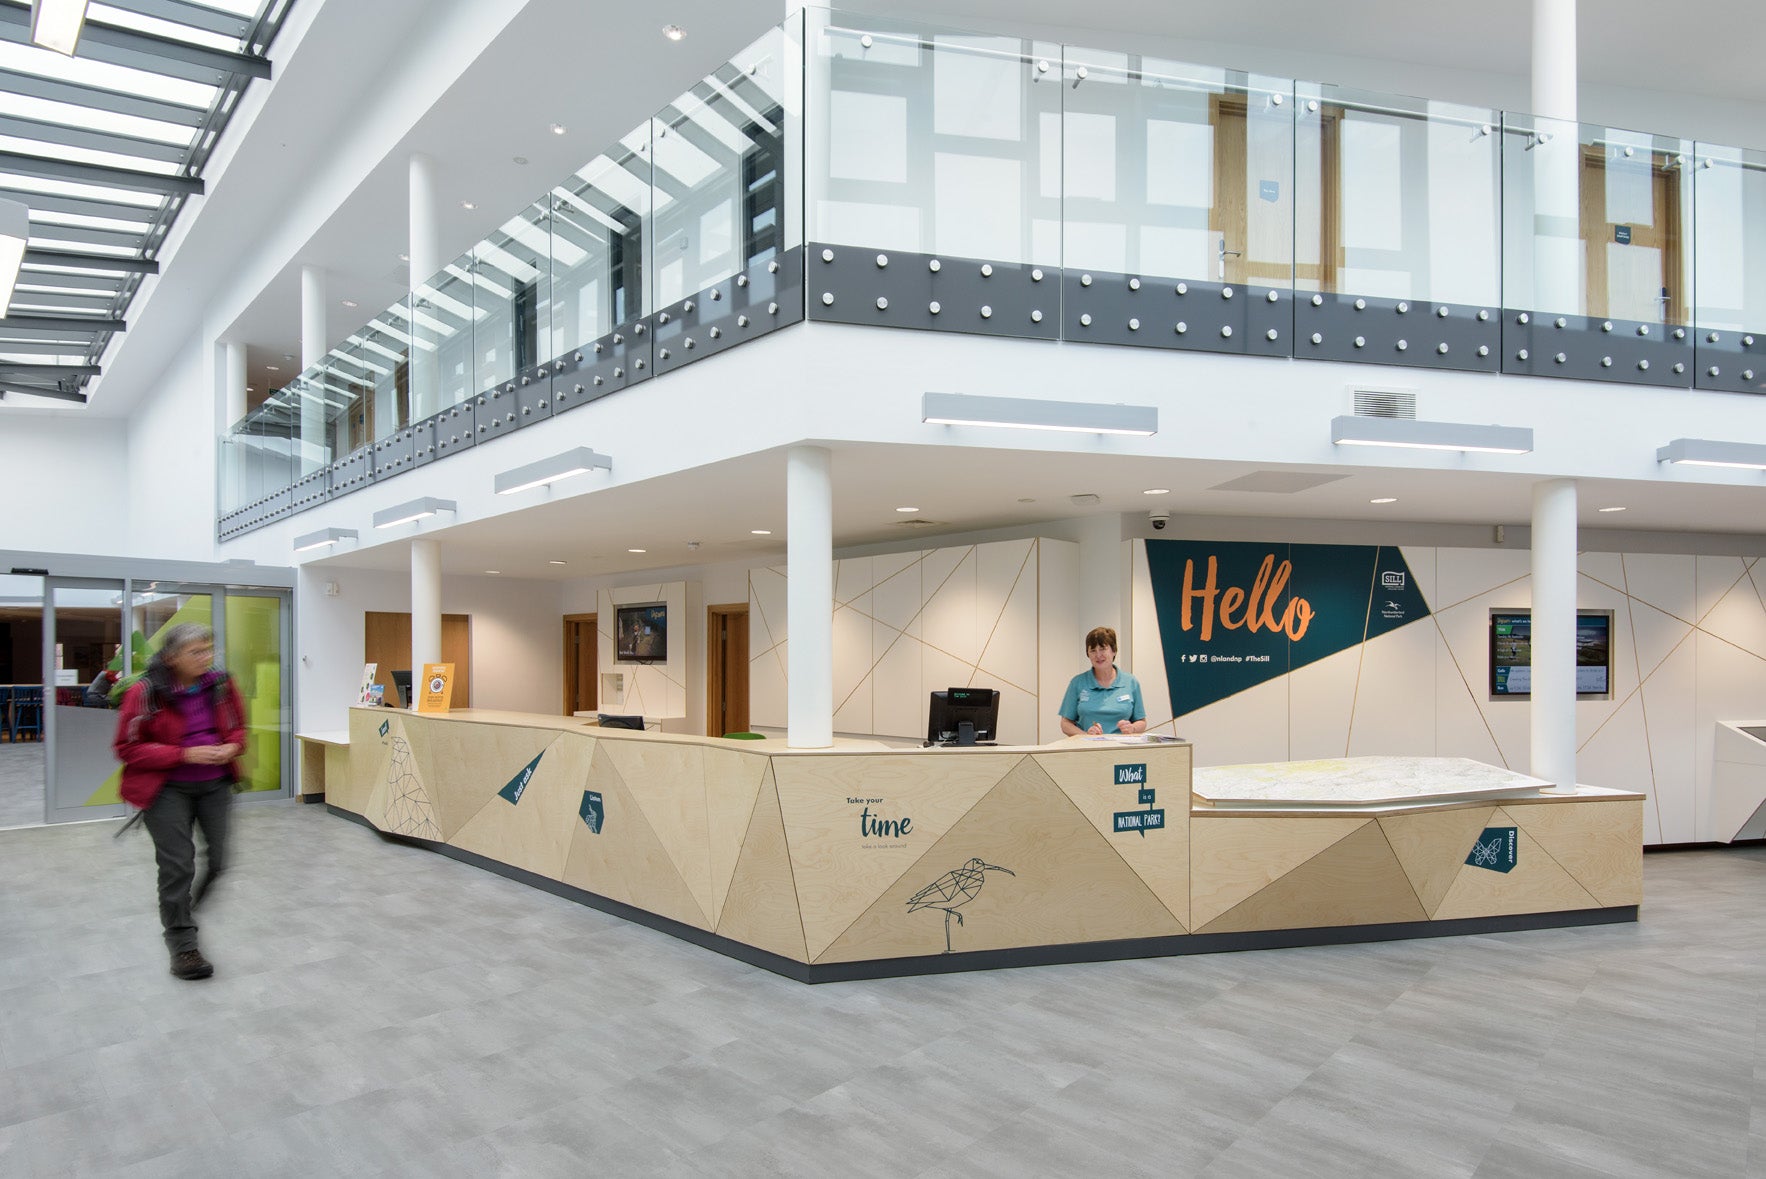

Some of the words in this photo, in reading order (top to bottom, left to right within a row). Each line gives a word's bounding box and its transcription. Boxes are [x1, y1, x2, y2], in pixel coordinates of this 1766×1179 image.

[1385, 575, 1402, 583] SILL
[1181, 554, 1315, 642] Hello
[514, 782, 524, 801] Just
[523, 767, 532, 784] ask
[1119, 766, 1143, 782] What
[860, 807, 914, 838] time
[1117, 815, 1142, 829] NATIONAL
[1143, 814, 1161, 826] PARK?
